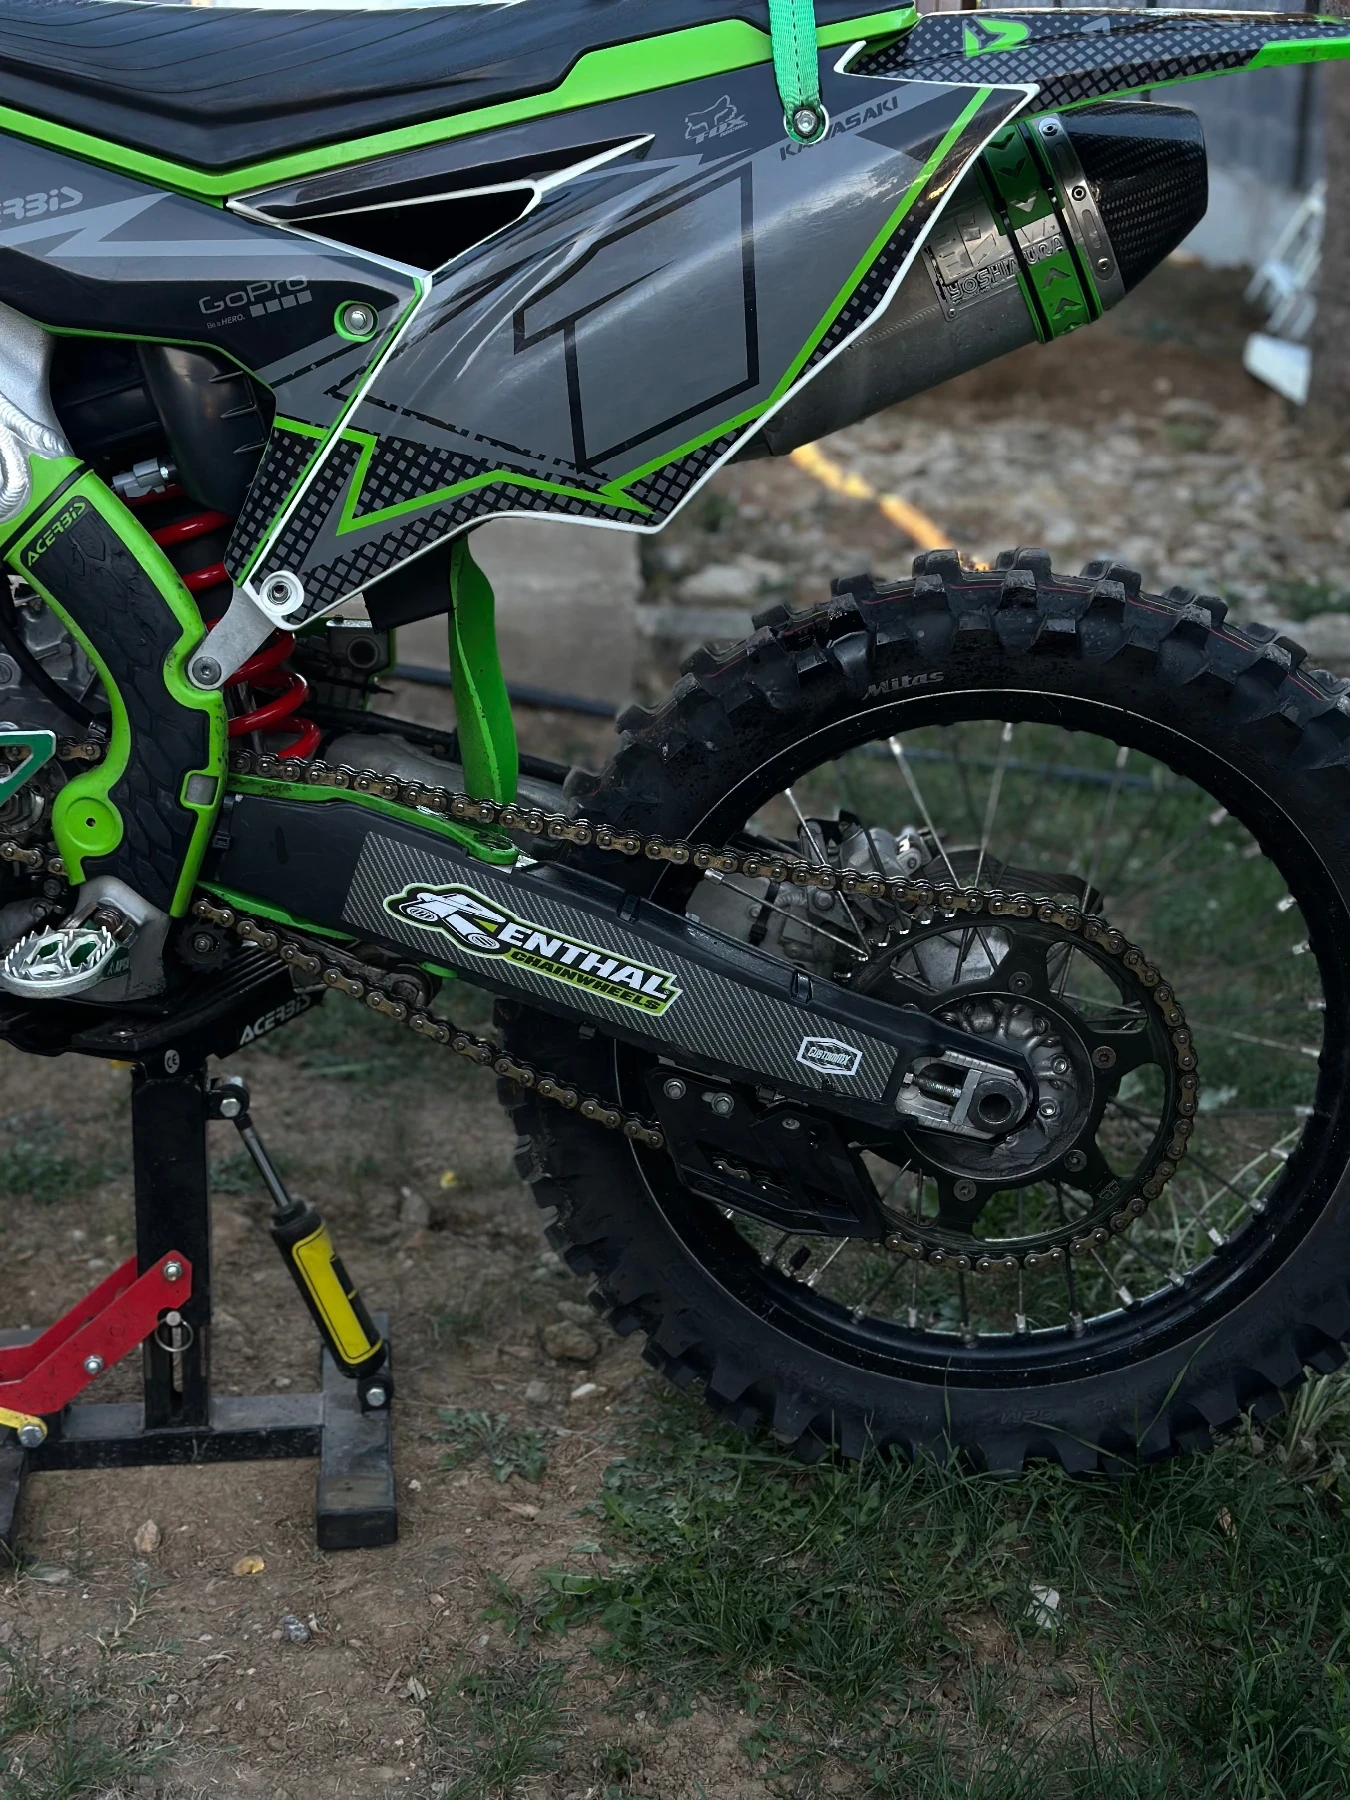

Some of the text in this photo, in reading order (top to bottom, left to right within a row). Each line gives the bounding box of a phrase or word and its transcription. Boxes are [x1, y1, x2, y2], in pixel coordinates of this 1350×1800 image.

[696, 114, 745, 144] FOX
[780, 96, 898, 161] KASAKI
[198, 275, 308, 314] GoPro
[862, 671, 944, 701] Mitas
[510, 949, 661, 1011] CHAINWHEELS
